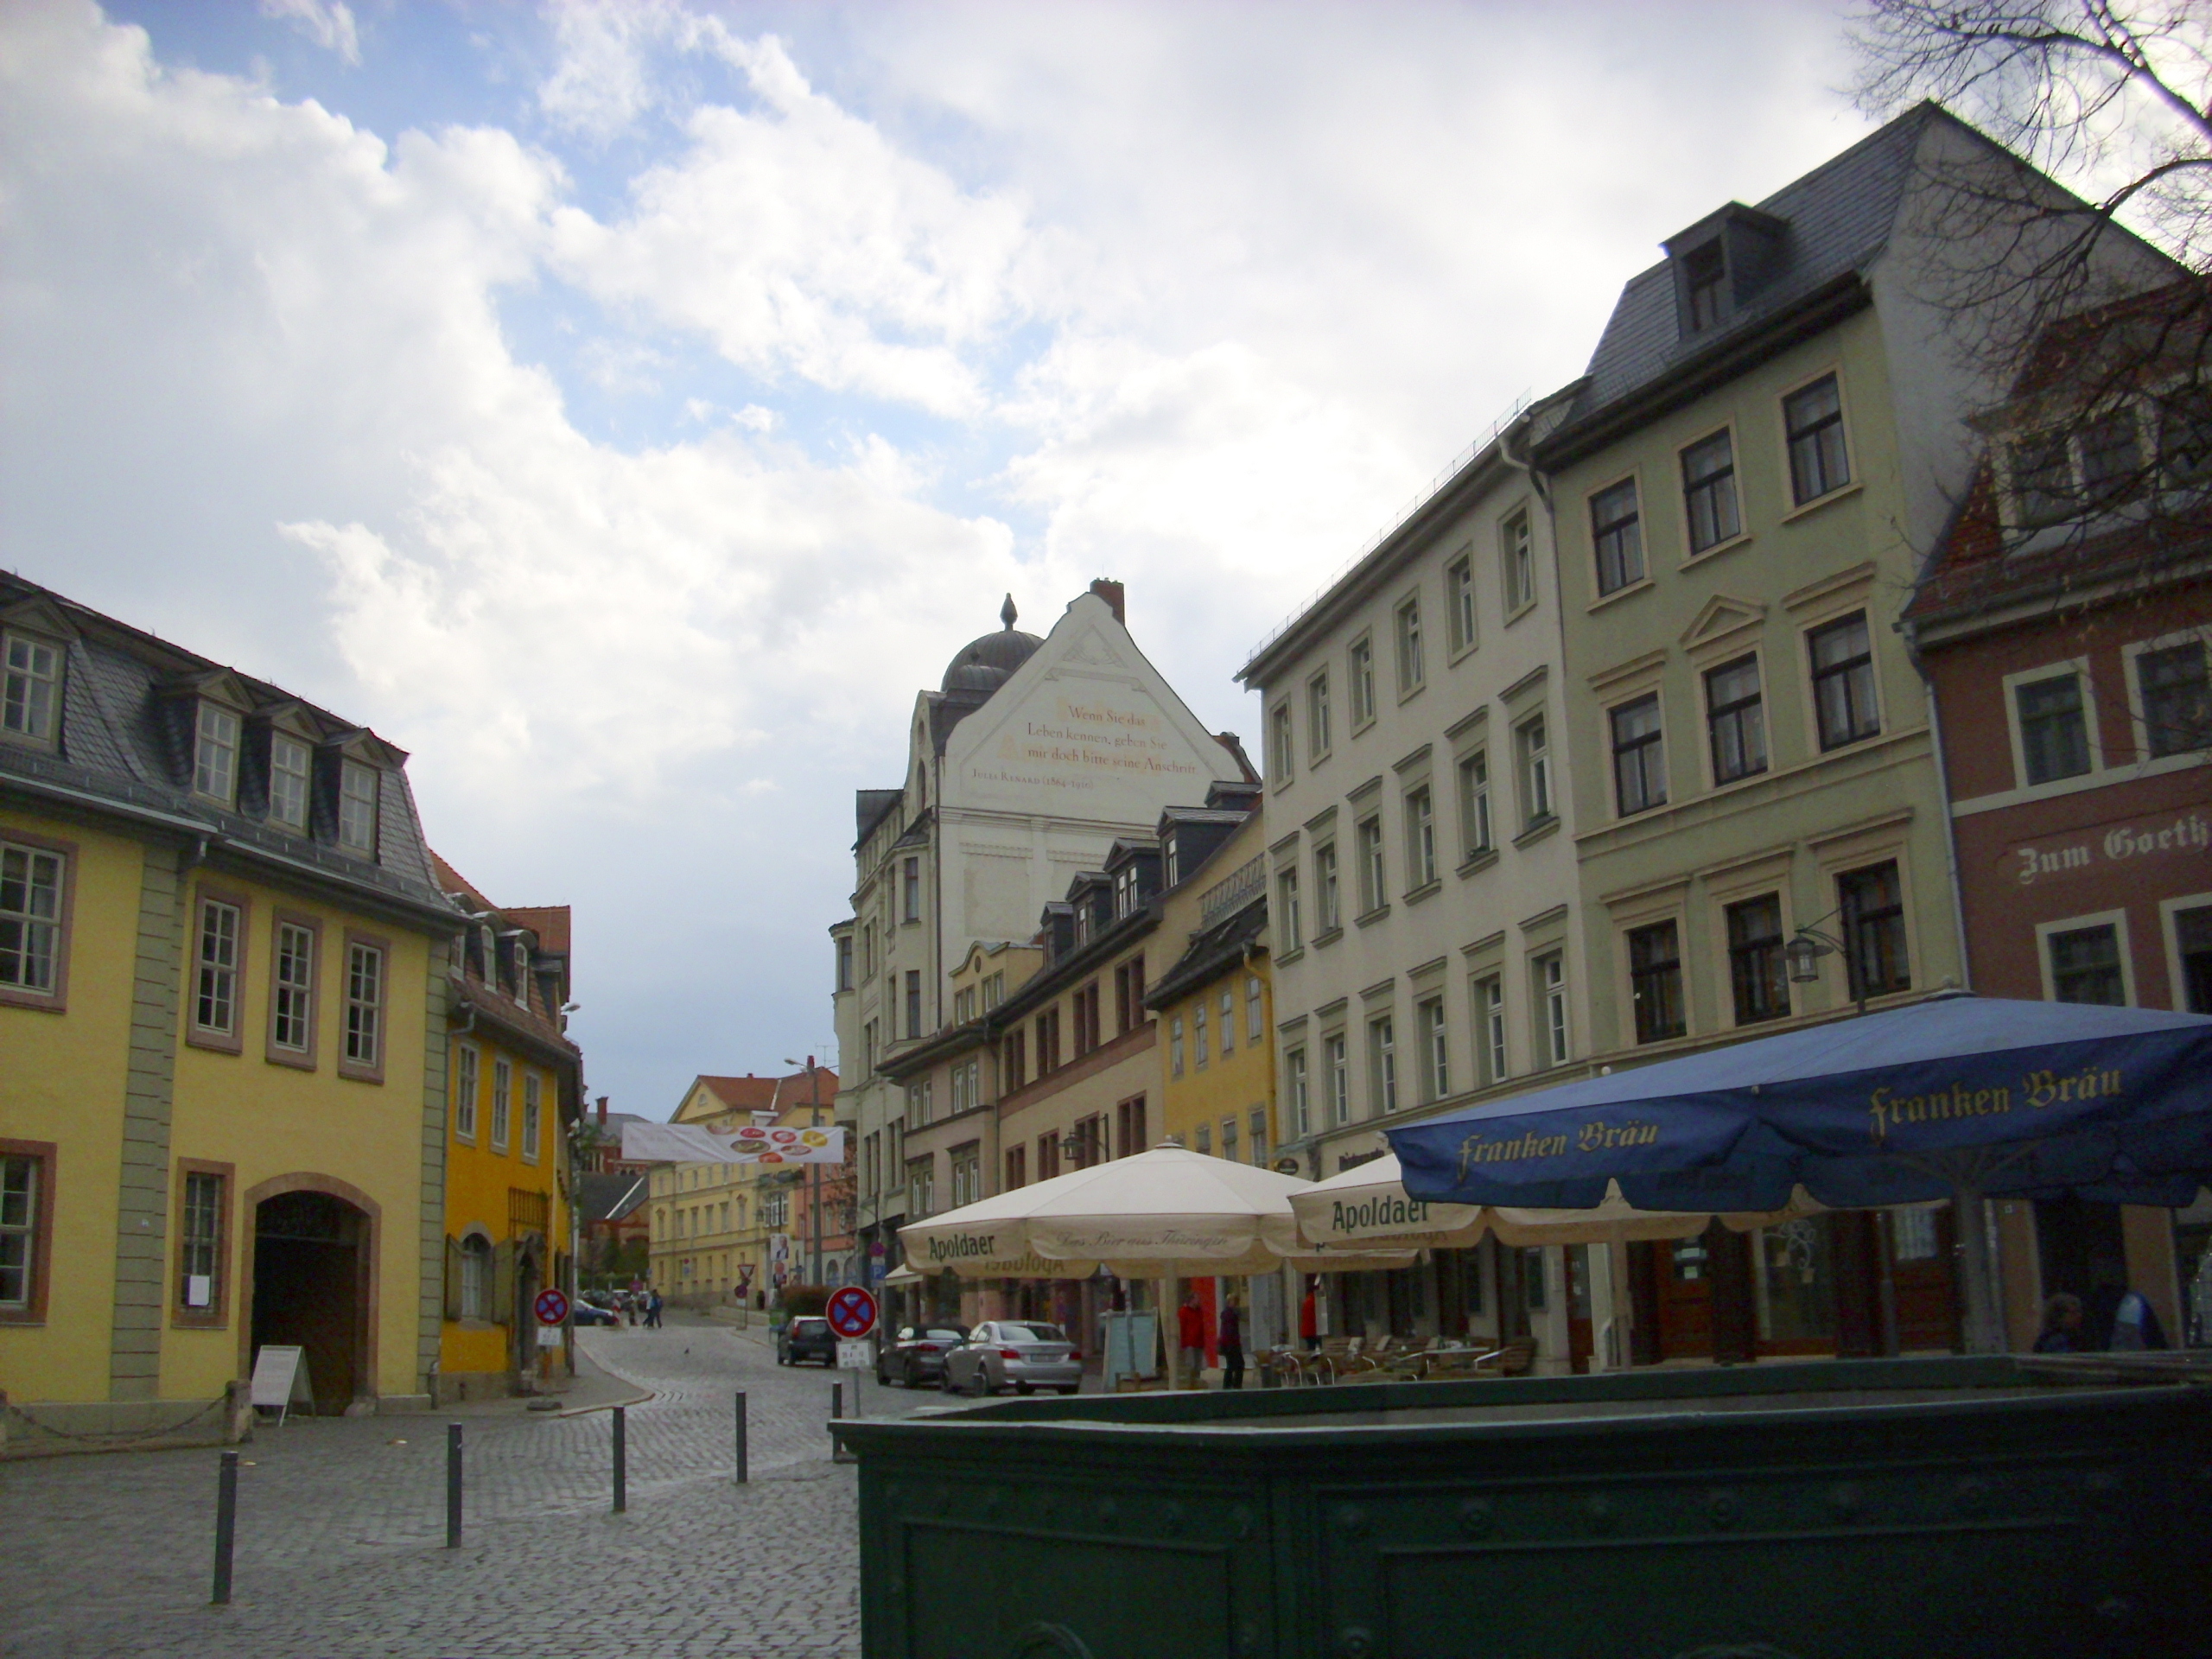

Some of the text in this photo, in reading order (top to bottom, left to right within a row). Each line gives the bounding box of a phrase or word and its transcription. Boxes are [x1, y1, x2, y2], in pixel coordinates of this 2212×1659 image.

[1068, 704, 1147, 727] Wenn Sie das
[1027, 721, 1064, 740] Leben
[1114, 733, 1147, 748] geben
[1150, 735, 1167, 750] Sie
[1027, 747, 1198, 774] mir doch bitte seine Anschrift
[2017, 845, 2091, 886] Zum
[1867, 1065, 2122, 1147] Franken Bräu
[1456, 1119, 1660, 1184] Franken Bräu
[1332, 1195, 1428, 1234] Apoldaer
[928, 1232, 995, 1262] Apoldaer
[1127, 1236, 1154, 1246] aus
